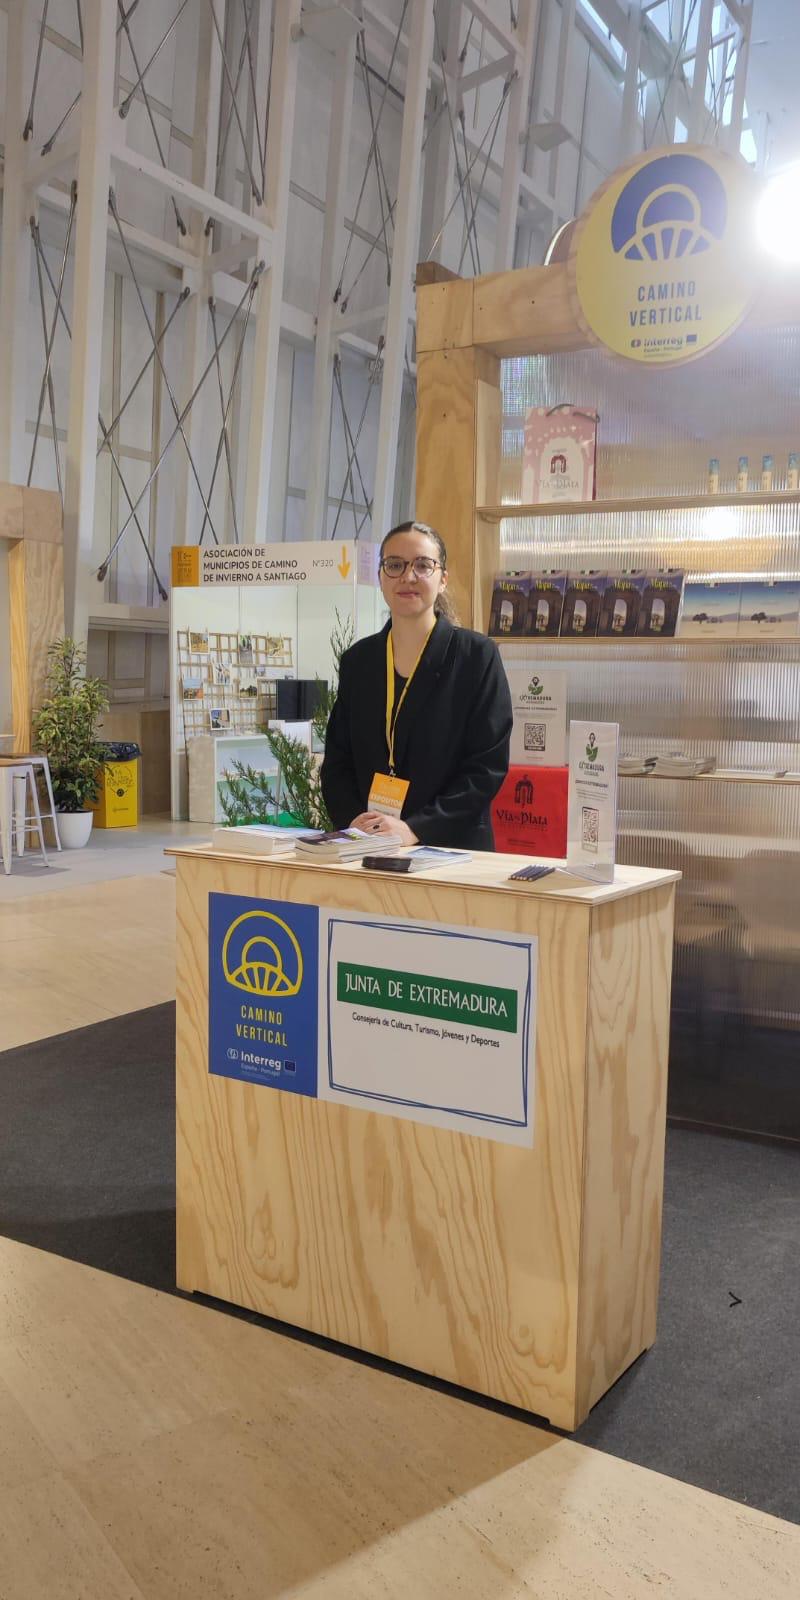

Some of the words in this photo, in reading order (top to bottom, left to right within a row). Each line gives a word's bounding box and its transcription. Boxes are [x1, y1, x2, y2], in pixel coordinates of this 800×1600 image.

[637, 281, 696, 302] CAMINO
[629, 304, 703, 327] VERTICAL
[203, 548, 253, 558] ASOCIACIÓN
[254, 548, 265, 557] DE
[203, 561, 250, 570] MUNICIPIOS
[251, 560, 263, 569] DE
[264, 559, 298, 569] CAMINO
[203, 573, 214, 582] DE
[215, 573, 254, 582] INVIERNO
[255, 573, 263, 582] A
[264, 572, 307, 581] SANTIAGO
[345, 973, 381, 995] JUNTA
[388, 980, 403, 998] DE
[409, 983, 508, 1018] EXTREMADURA
[240, 1004, 282, 1025] CAMINO
[236, 1023, 288, 1047] VERTICAL
[352, 1011, 381, 1026] Consejería
[382, 1018, 389, 1027] de
[390, 1018, 413, 1032] Cultura,
[415, 1023, 440, 1037] Turismo,
[465, 1035, 470, 1044] y
[471, 1034, 500, 1048] Deportes
[240, 1050, 282, 1070] Interreg
